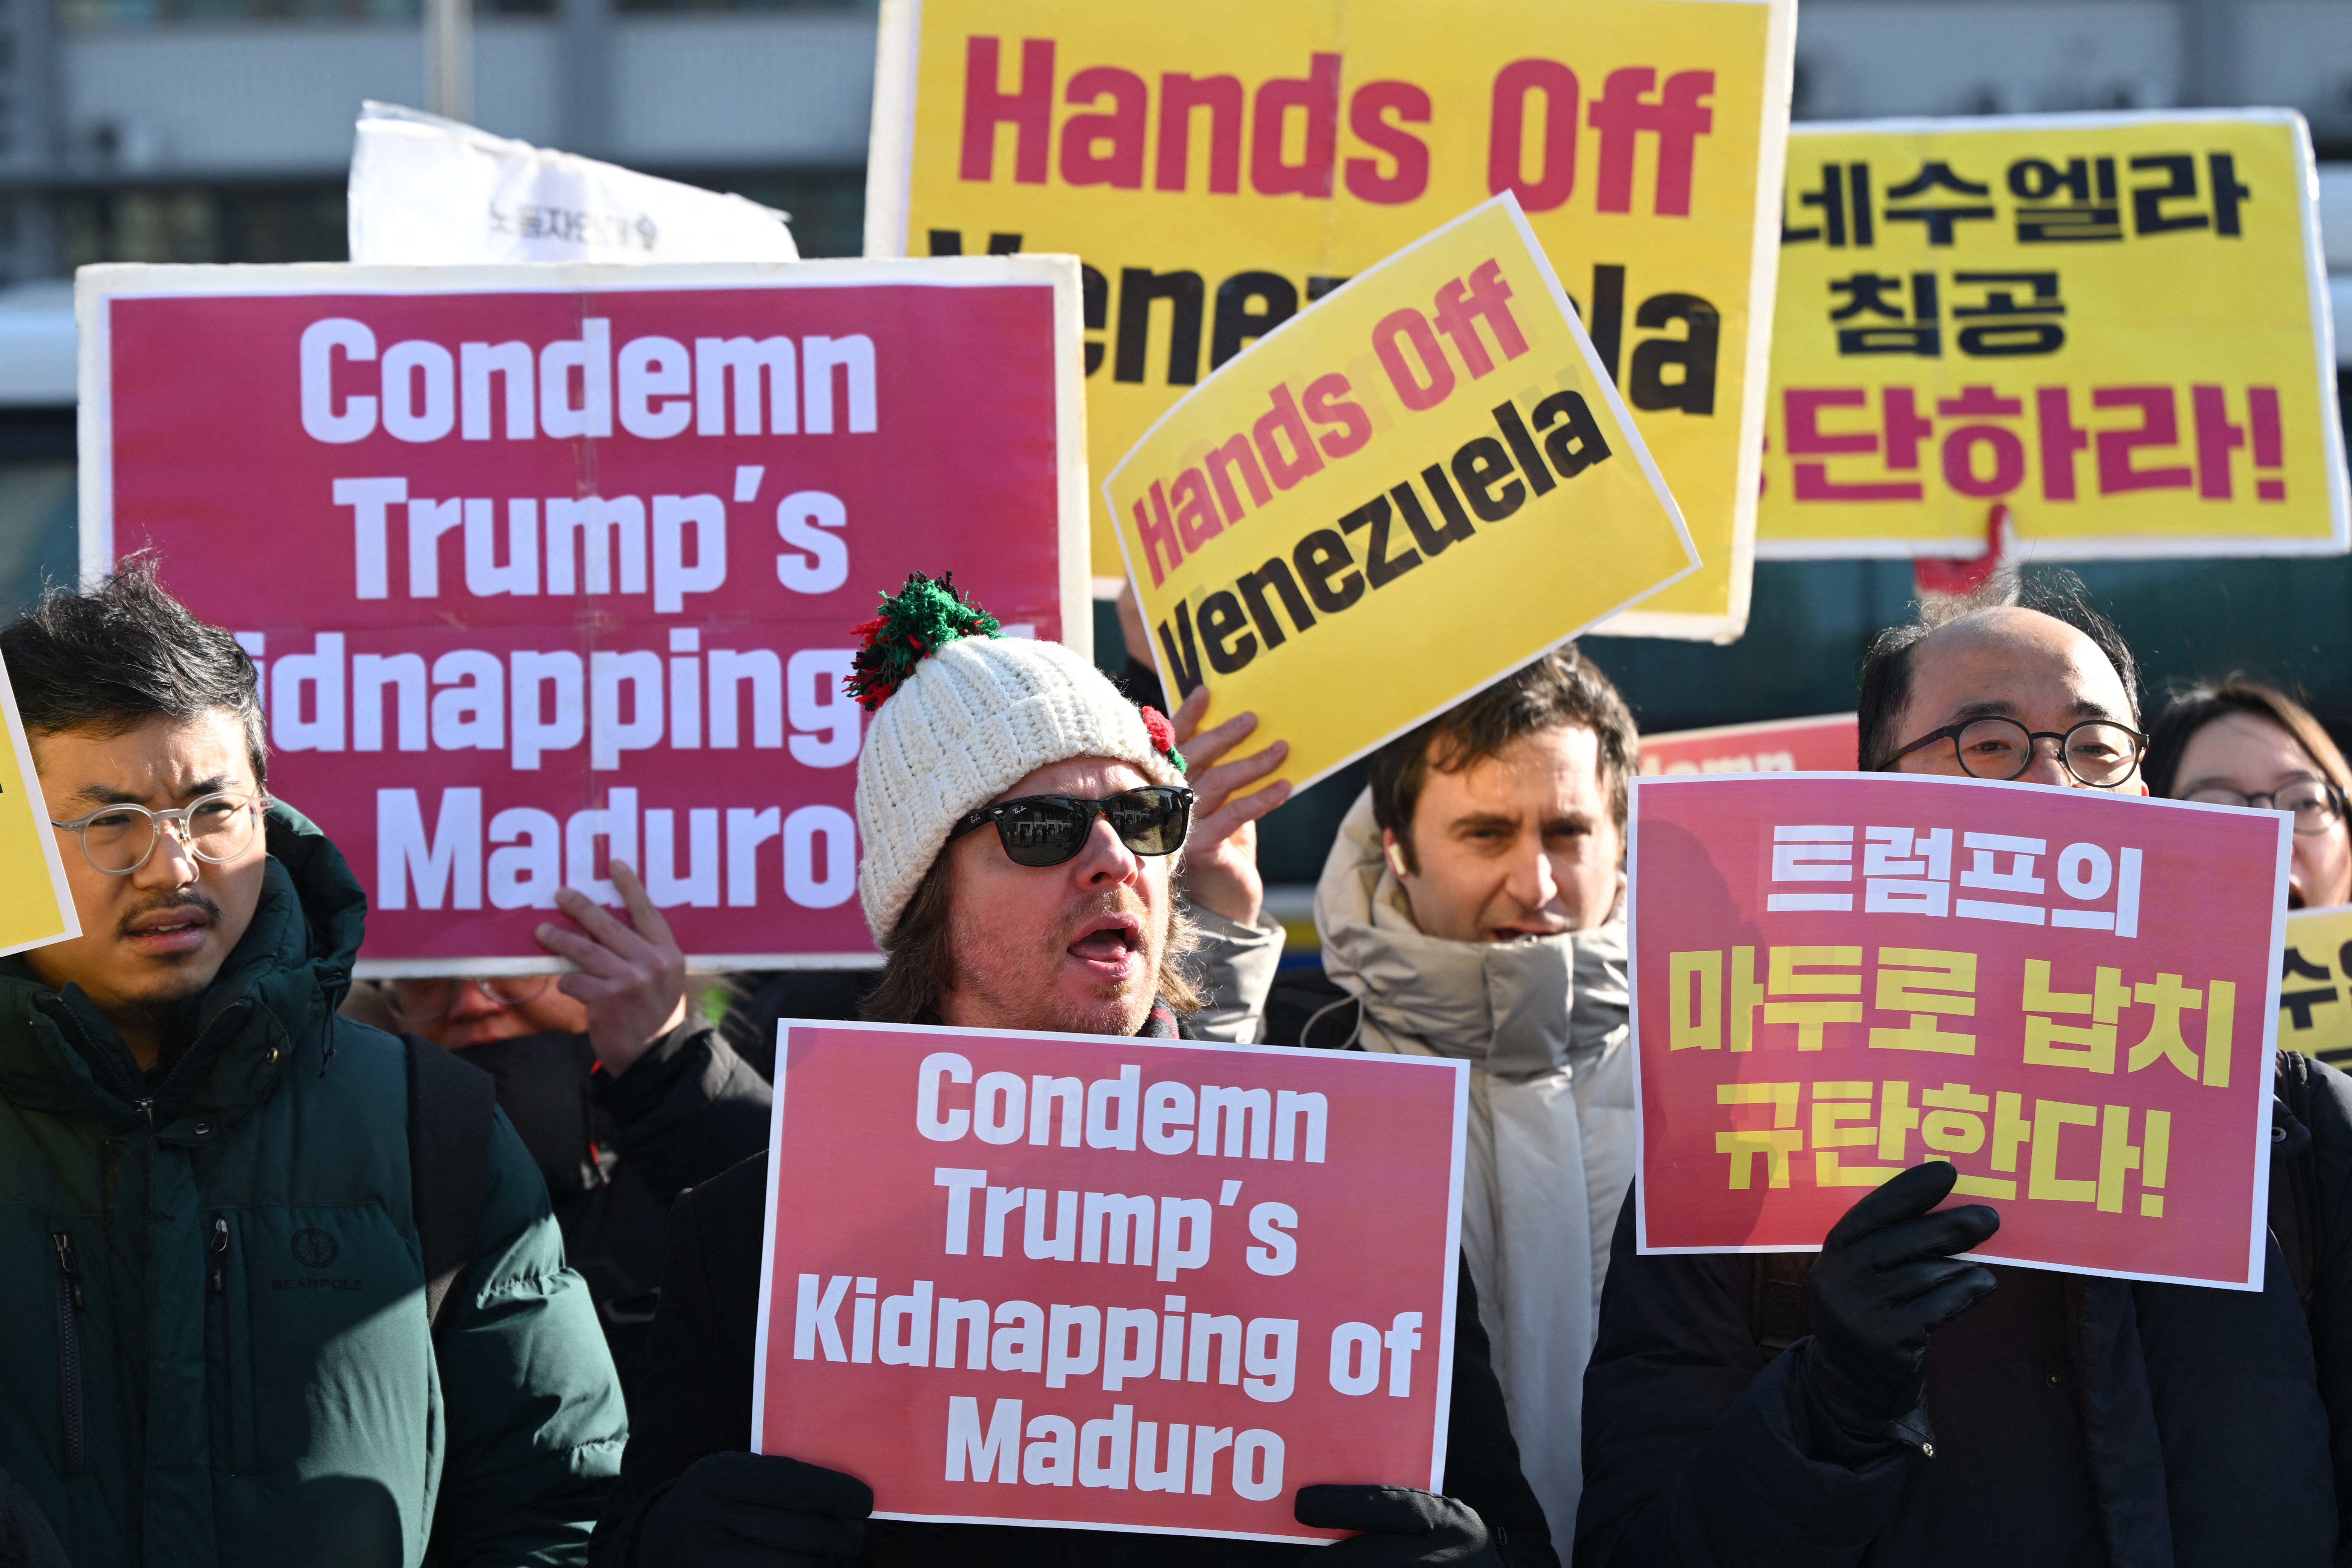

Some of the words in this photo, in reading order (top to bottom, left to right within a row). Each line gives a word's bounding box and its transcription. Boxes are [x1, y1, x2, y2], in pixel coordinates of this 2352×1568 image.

[958, 35, 1432, 206] Hands
[1487, 57, 1716, 217] Off
[1781, 151, 2252, 248] 네수엘라
[1827, 269, 2068, 358] 침공
[300, 317, 878, 444] Condemn
[1132, 372, 1373, 591] Hands
[1372, 257, 1530, 412] Off
[1759, 383, 2287, 503] 단하라!
[1157, 389, 1613, 701] Venezuela
[233, 628, 861, 770] dnapping
[377, 787, 856, 910] Maduro
[1767, 825, 2142, 938] 트럼프의
[1669, 945, 1978, 1056] 마두로
[2022, 958, 2236, 1088] 납치
[916, 1052, 1328, 1163] Condemn
[1715, 1080, 2171, 1218] 규탄한다!
[272, 1278, 363, 1290] BEANPOLE
[793, 1273, 1299, 1403] Kidnapping
[1329, 1311, 1422, 1397] of
[945, 1396, 1285, 1501] Maduro
